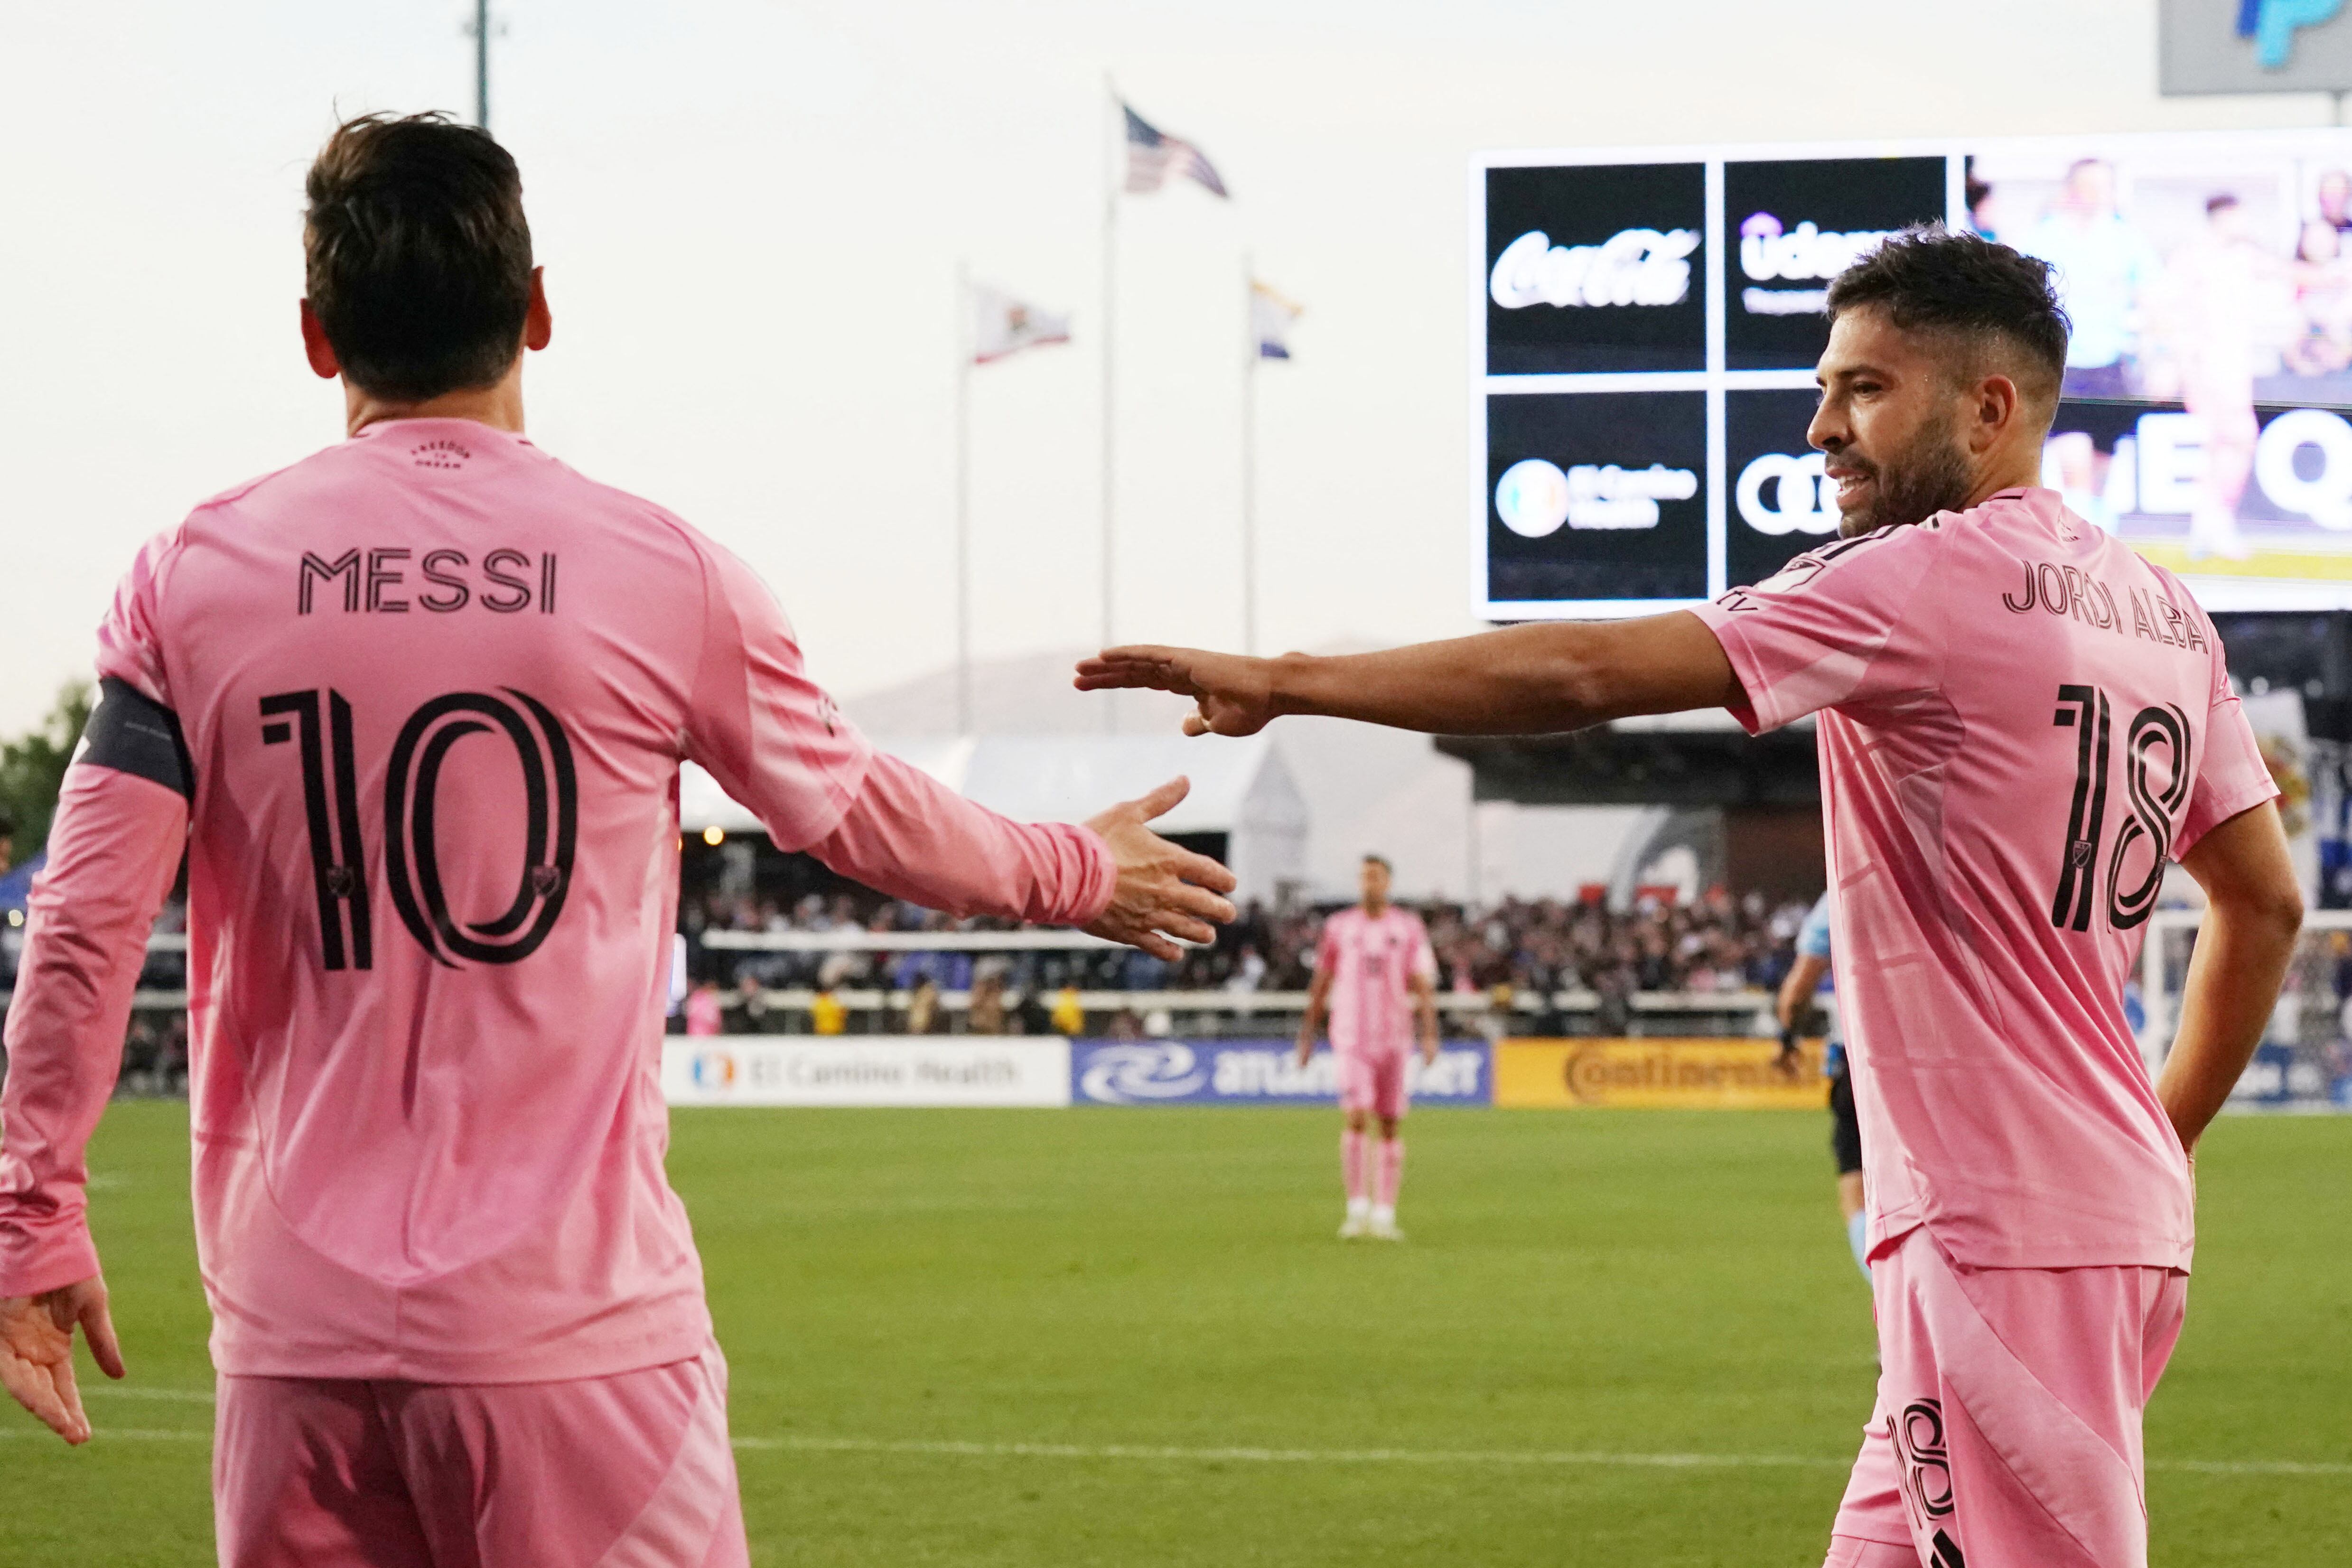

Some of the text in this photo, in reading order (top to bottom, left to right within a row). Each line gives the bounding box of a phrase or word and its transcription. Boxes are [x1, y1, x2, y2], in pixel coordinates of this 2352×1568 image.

[298, 548, 557, 615] MESSI
[2002, 560, 2208, 654] JORDI ALBA
[260, 685, 578, 970] 10
[2051, 684, 2191, 934] 18
